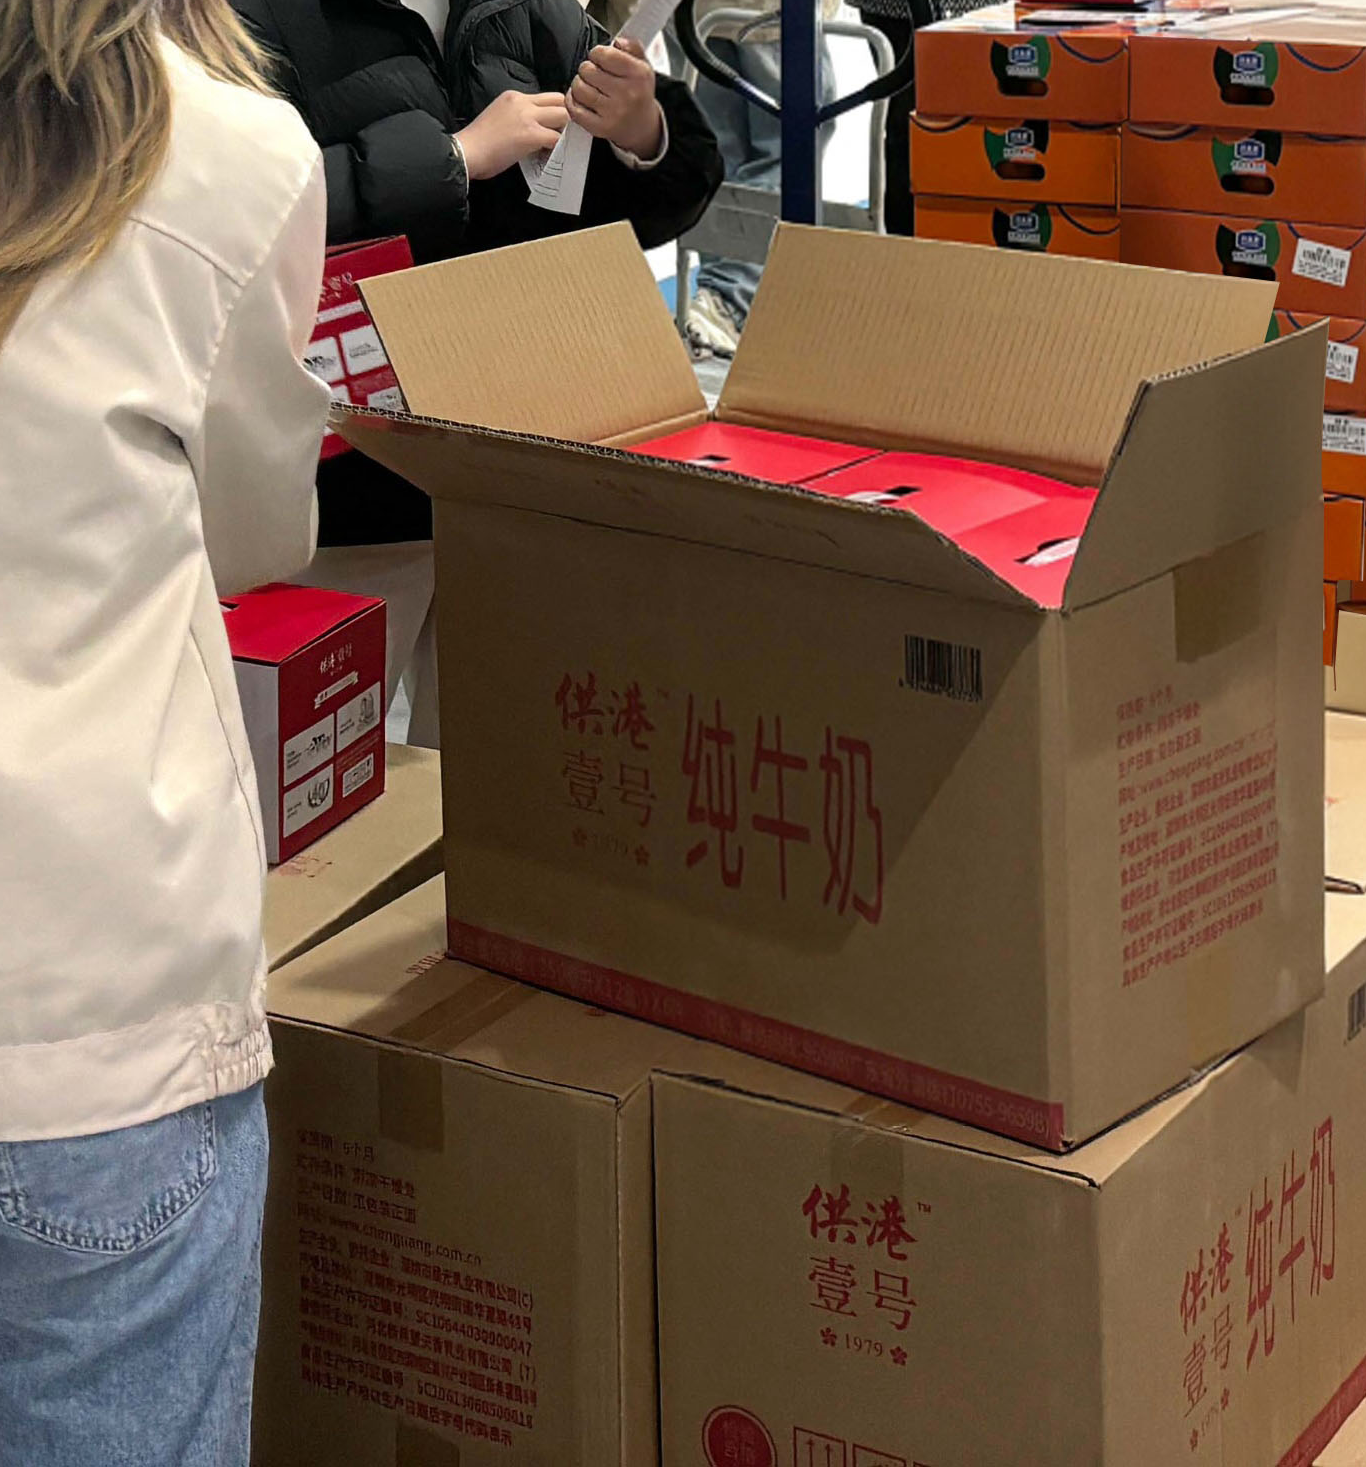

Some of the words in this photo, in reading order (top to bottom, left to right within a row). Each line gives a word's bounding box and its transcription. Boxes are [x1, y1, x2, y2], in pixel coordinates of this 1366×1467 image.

[554, 670, 656, 751] 供港
[561, 749, 658, 829] 壹号
[681, 692, 884, 925] 纯牛奶
[802, 1183, 919, 1261] 供港
[1245, 1115, 1336, 1373] 纯牛奶
[808, 1256, 918, 1332] 壹号
[1180, 1222, 1235, 1336] 供港
[844, 1333, 884, 1358] 1979
[1183, 1303, 1235, 1419] 壹号
